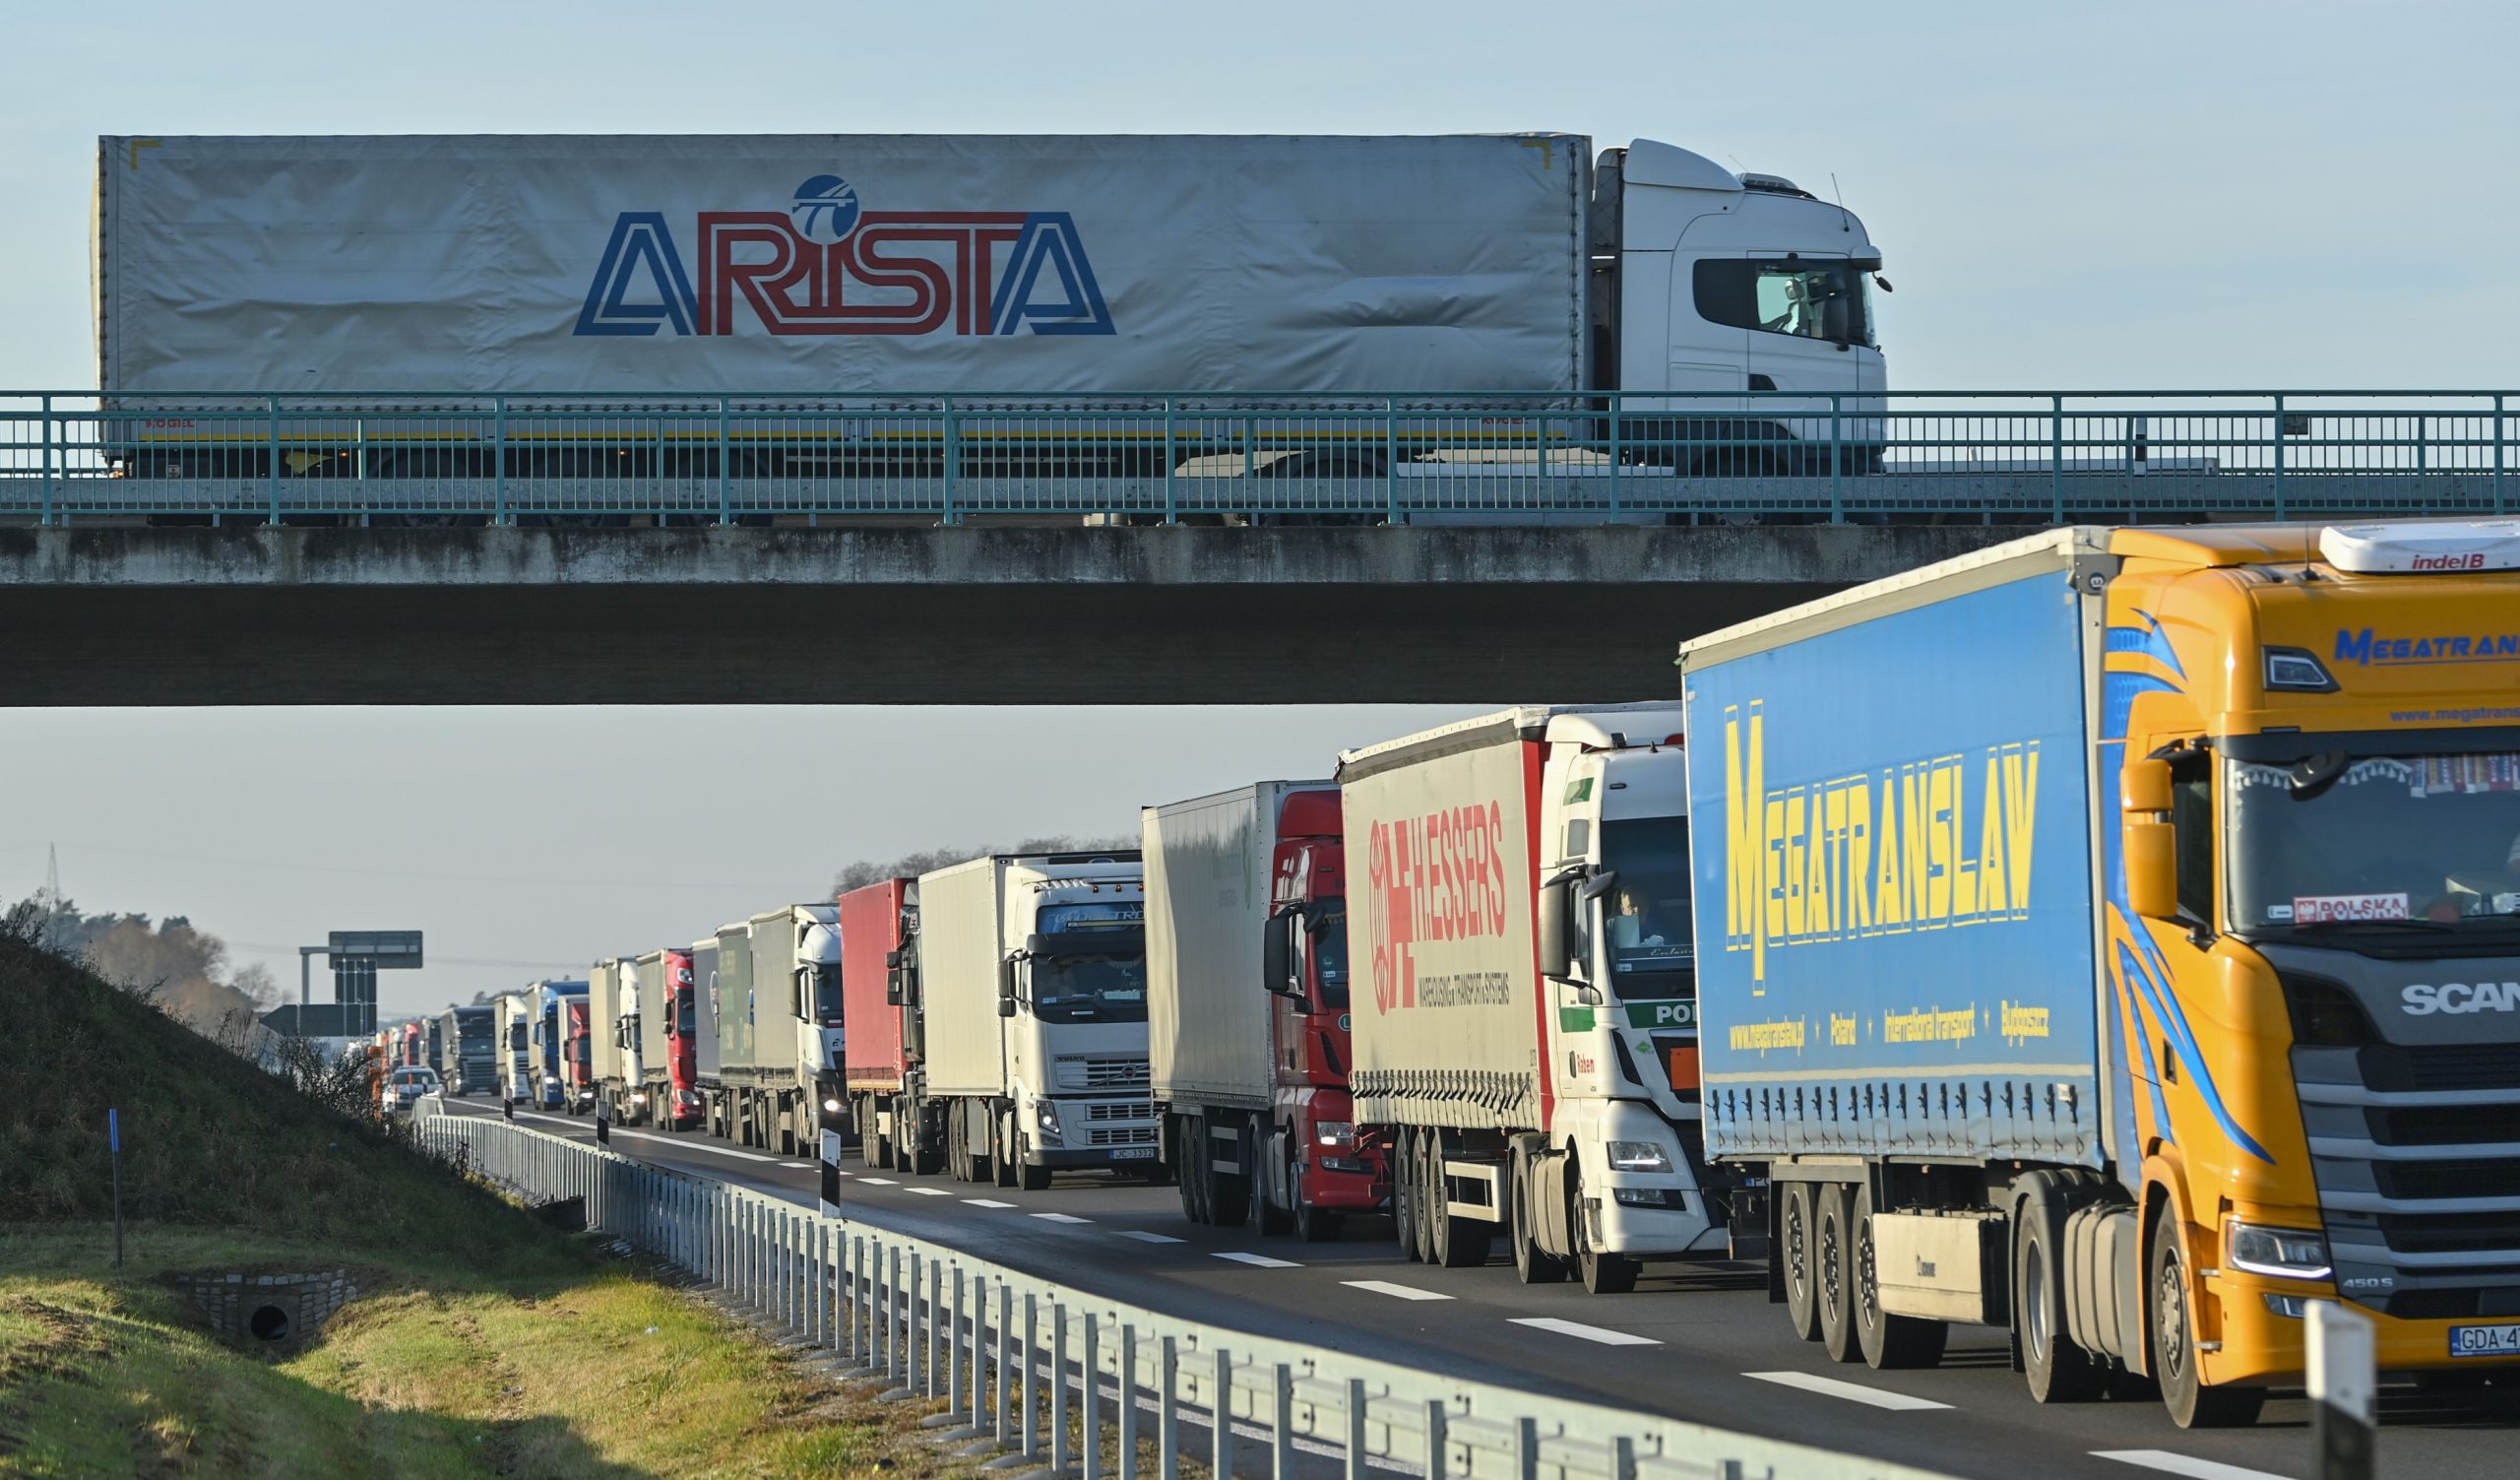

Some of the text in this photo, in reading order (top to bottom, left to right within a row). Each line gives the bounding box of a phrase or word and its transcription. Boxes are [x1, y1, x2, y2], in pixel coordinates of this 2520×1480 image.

[572, 175, 1117, 336] ARISTA
[2334, 627, 2520, 666] MEGATRAN
[1725, 698, 2041, 997] MEGATRANSLAW
[2319, 898, 2405, 921] POLSKA
[2343, 1278, 2379, 1288] 450
[2462, 1327, 2520, 1349] GDA 4
